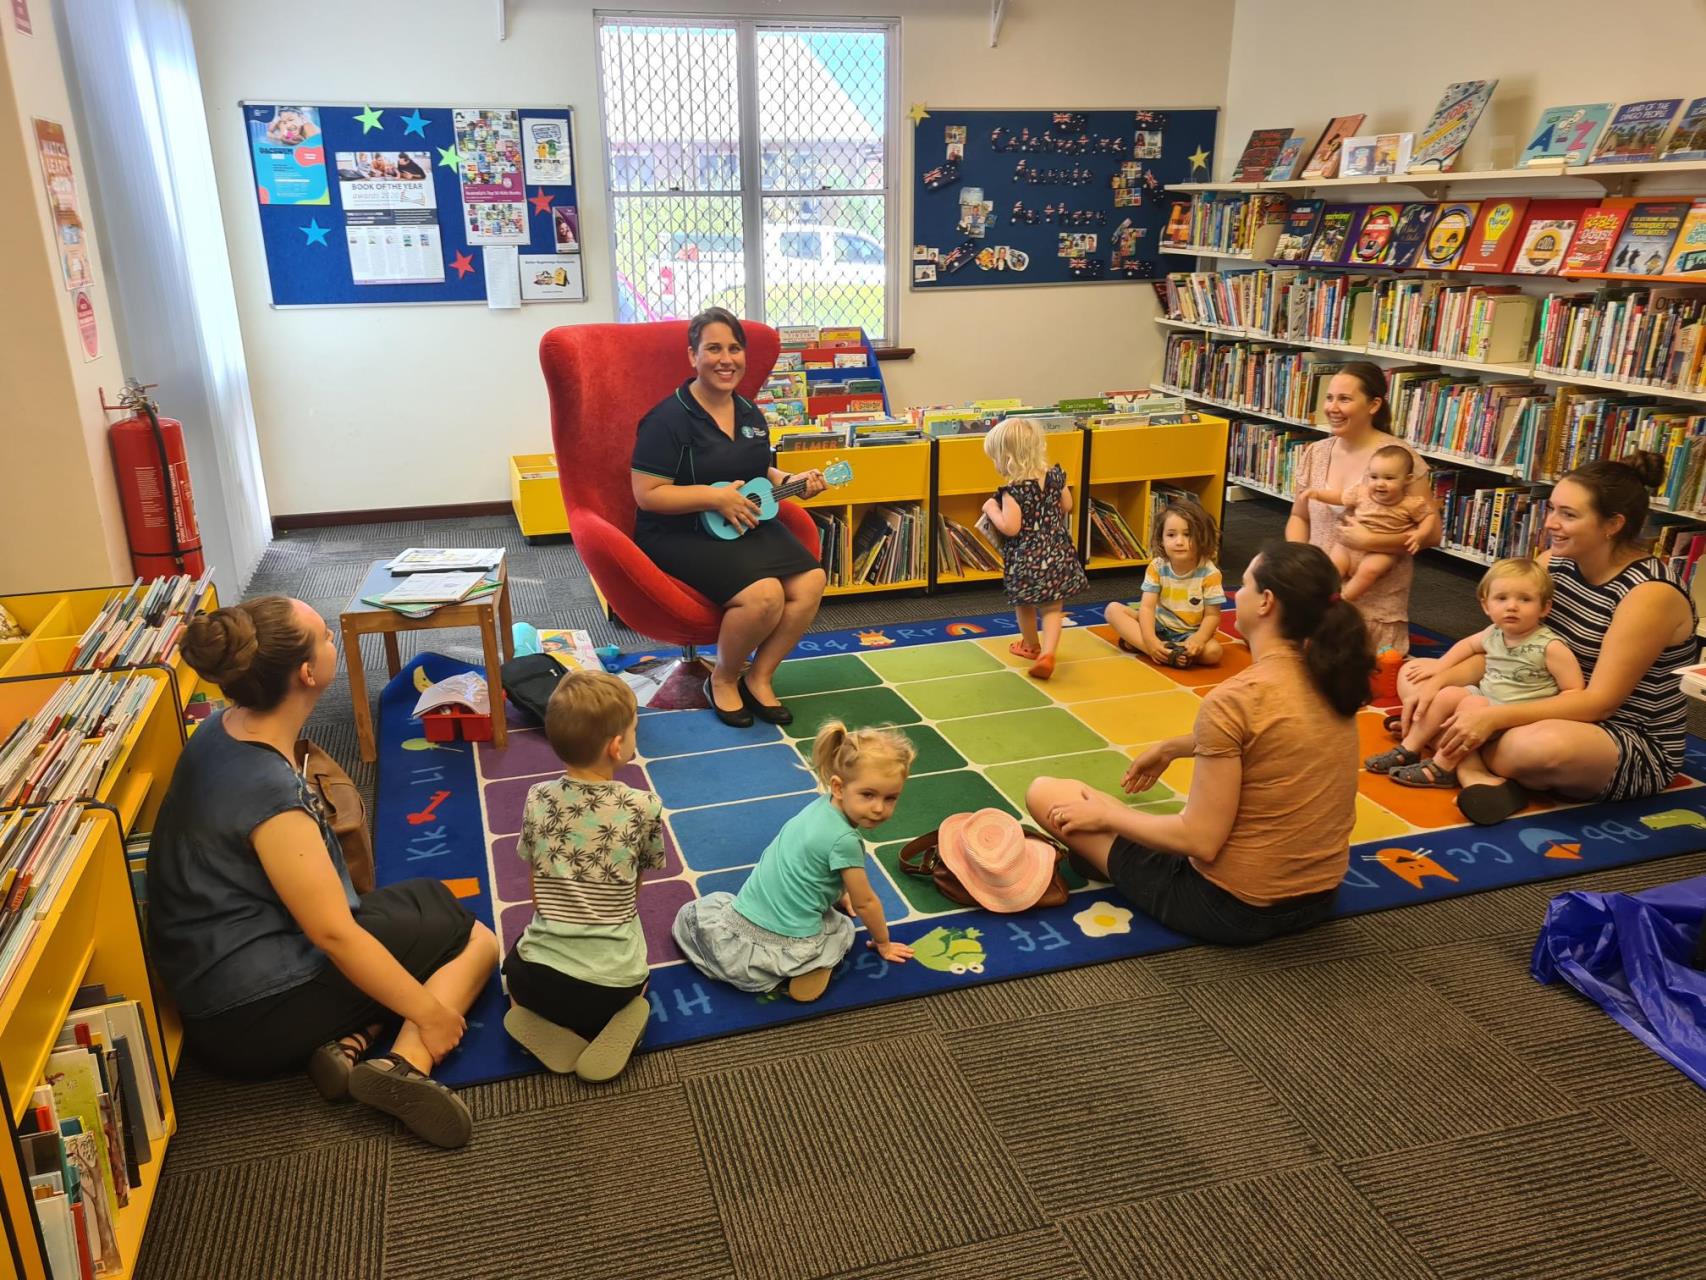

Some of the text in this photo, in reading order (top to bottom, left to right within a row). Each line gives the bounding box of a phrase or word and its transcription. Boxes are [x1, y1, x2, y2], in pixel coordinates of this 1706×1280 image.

[351, 183, 375, 191] BOOK
[402, 182, 424, 190] YEAR
[794, 439, 839, 451] ELMER
